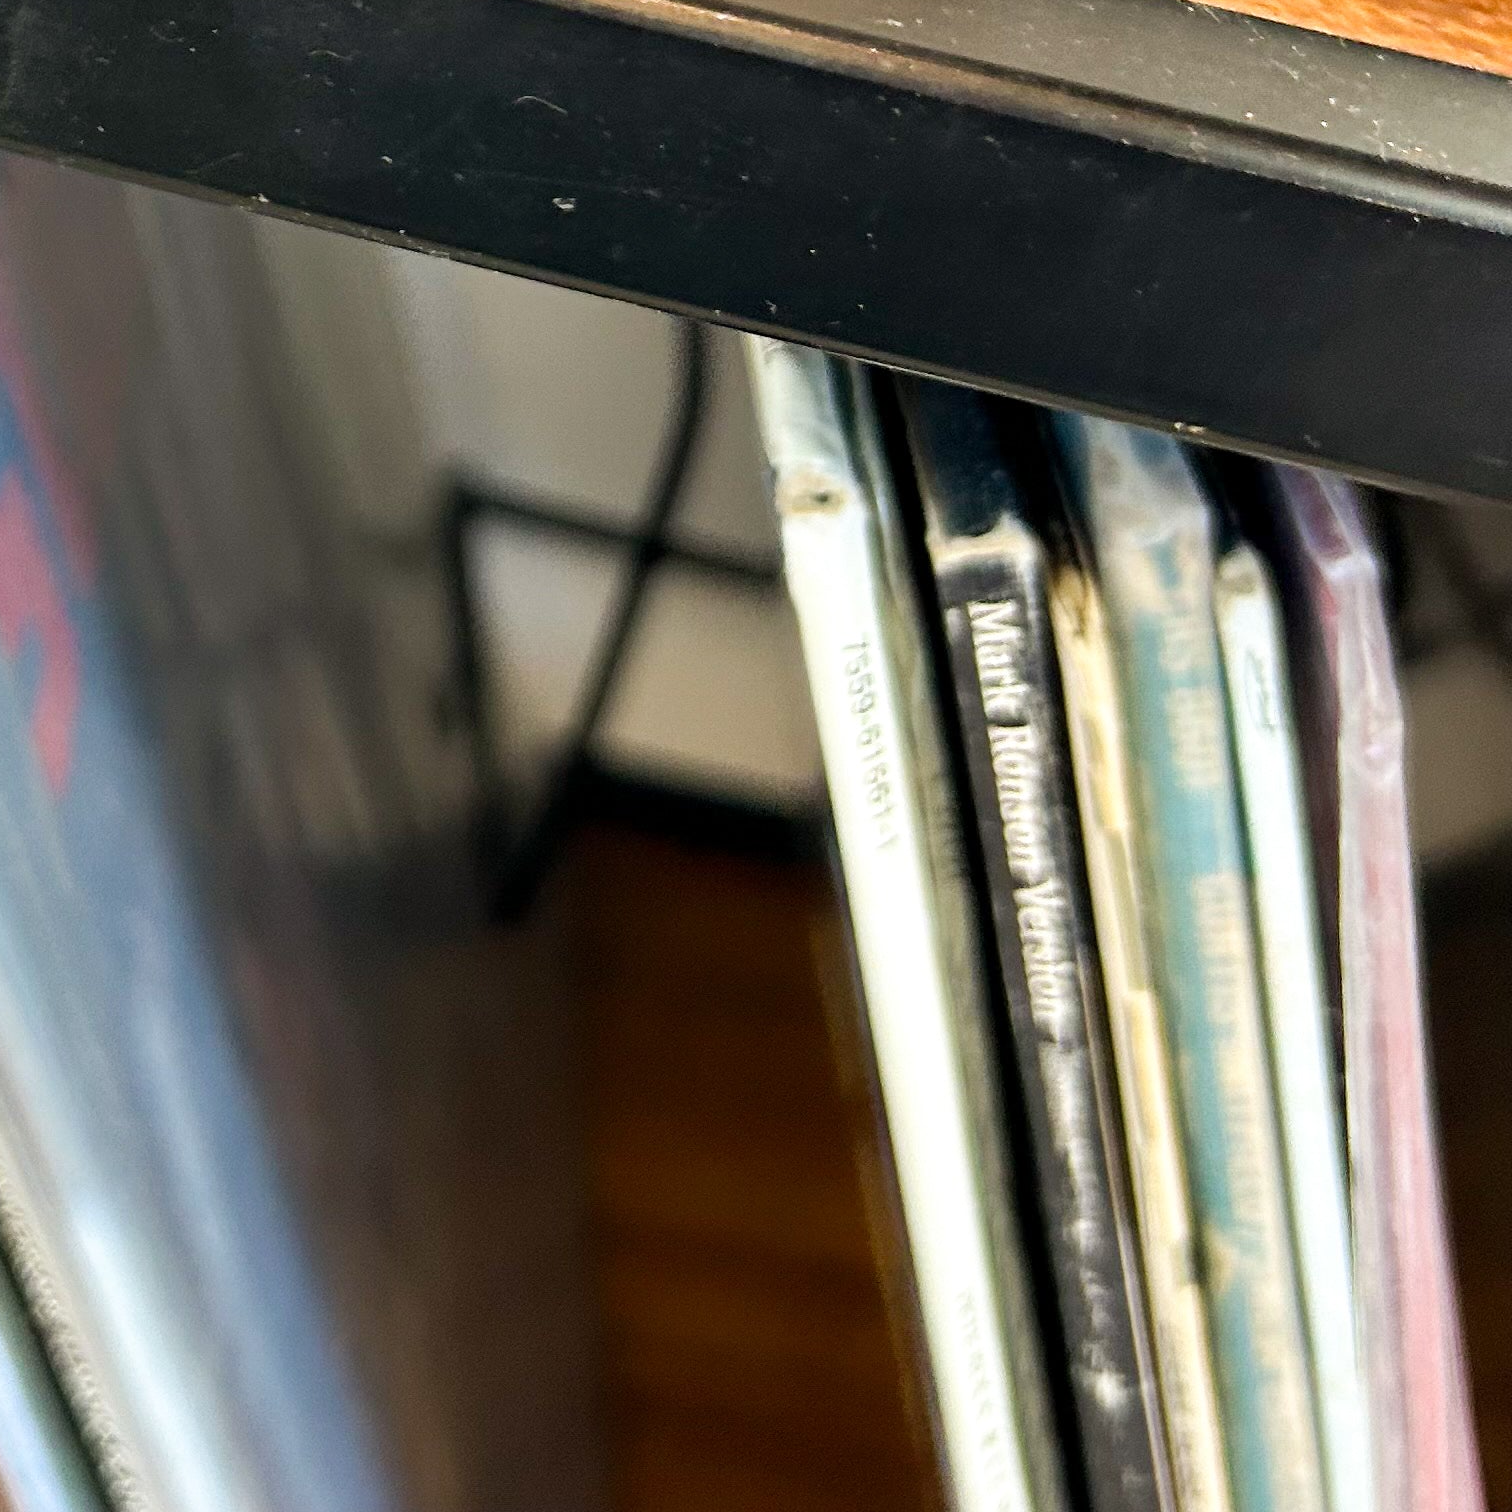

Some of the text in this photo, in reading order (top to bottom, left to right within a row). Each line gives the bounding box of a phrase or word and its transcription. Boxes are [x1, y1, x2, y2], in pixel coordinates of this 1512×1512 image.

[967, 599, 1078, 1034] Mark Ronson Version
